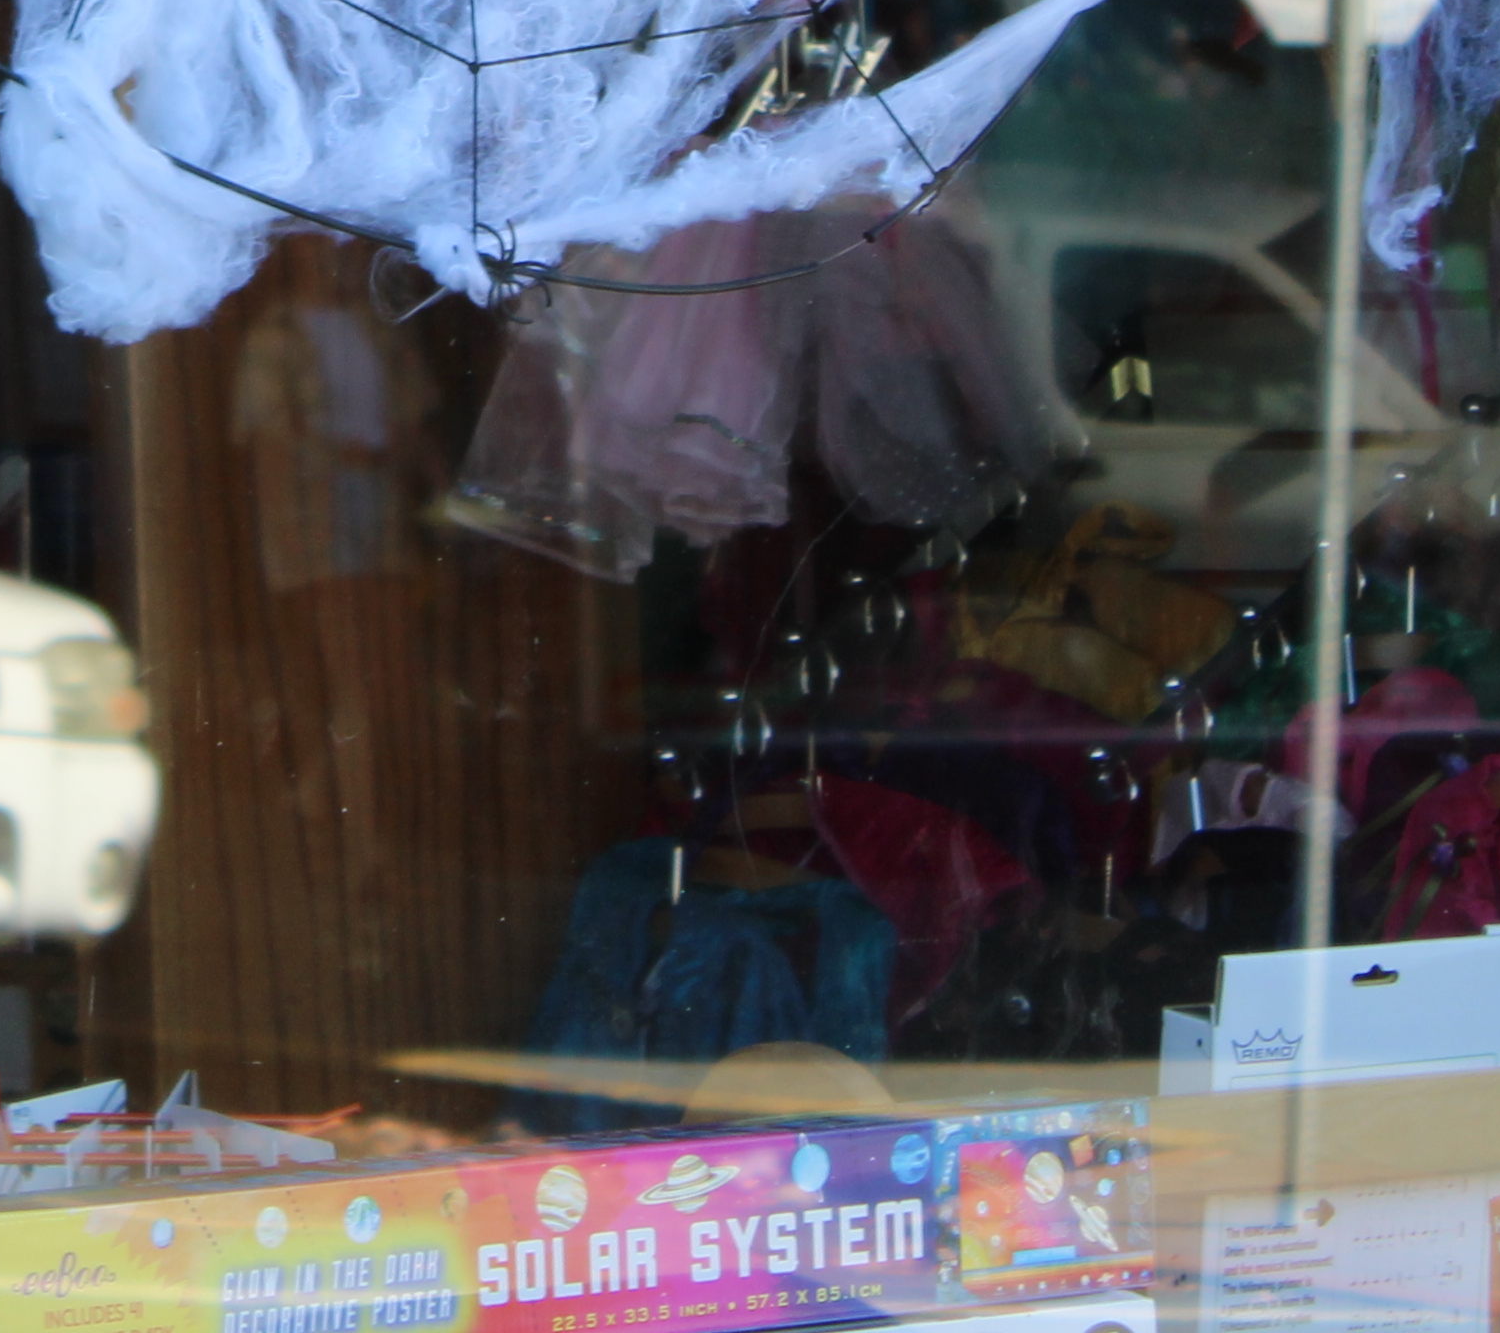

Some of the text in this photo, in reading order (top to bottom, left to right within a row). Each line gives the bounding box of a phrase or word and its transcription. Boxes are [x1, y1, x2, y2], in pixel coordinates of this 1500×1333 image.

[1241, 1045, 1293, 1061] REMO
[478, 1198, 925, 1307] SOLAR SYSTEM
[223, 1249, 440, 1303] GLOW IN THE DARK
[45, 1302, 126, 1330] INCLUDES
[224, 1288, 453, 1333] DECORATIVE POSTER
[551, 1312, 599, 1332] 22.5
[623, 1304, 671, 1325] 33.5
[679, 1301, 719, 1318] INCH
[746, 1291, 790, 1312] 57.2
